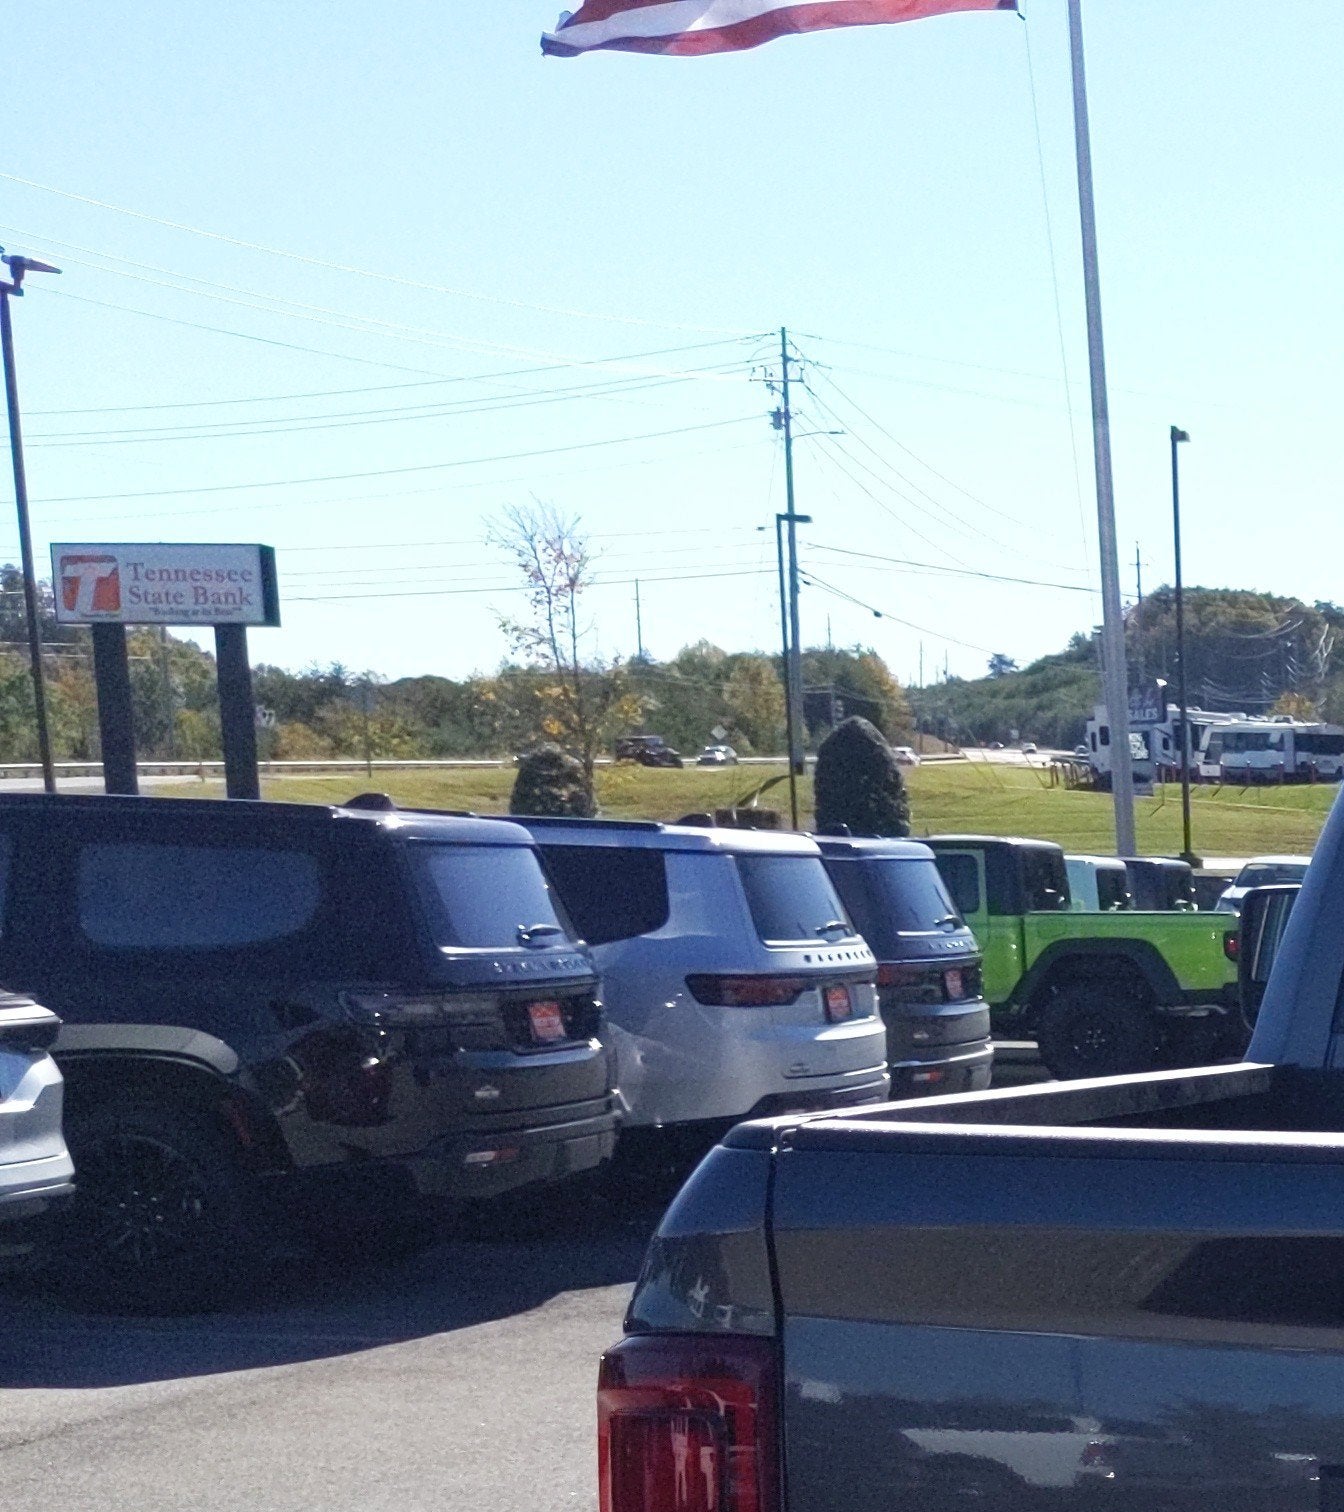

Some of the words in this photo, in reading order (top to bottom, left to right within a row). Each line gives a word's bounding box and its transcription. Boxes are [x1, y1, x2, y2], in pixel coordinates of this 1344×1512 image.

[126, 562, 253, 582] Tennessee
[128, 586, 184, 605] State
[192, 585, 253, 606] Bank
